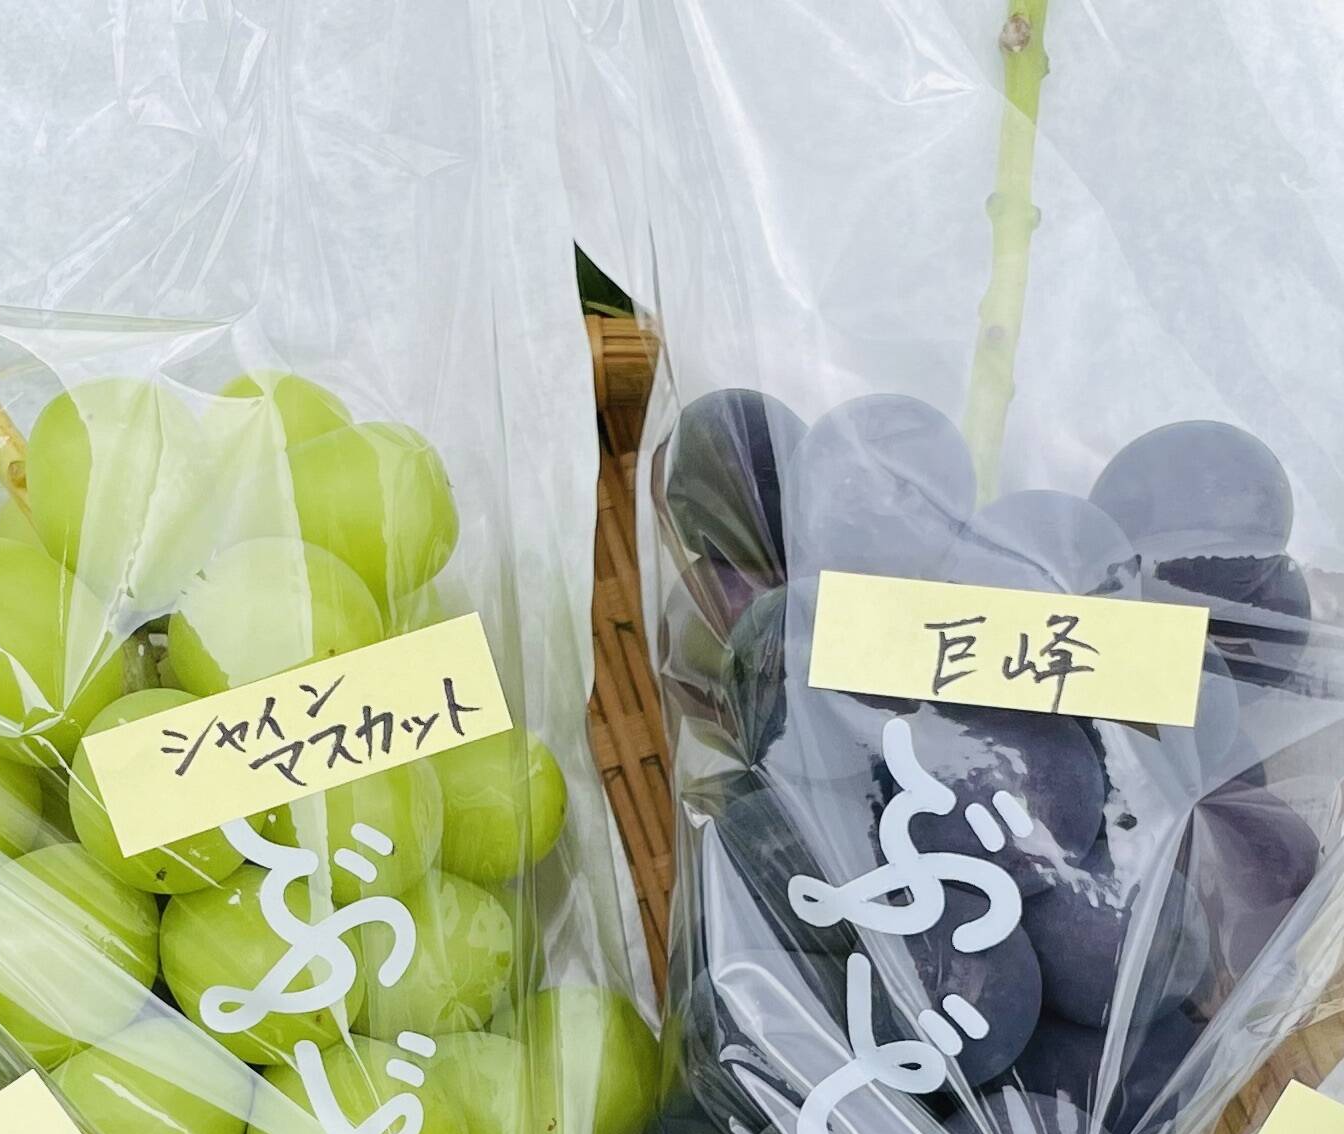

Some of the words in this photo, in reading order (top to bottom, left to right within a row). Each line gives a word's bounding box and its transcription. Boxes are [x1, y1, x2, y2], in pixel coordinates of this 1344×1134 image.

[925, 613, 1099, 711] 巨峰
[161, 675, 345, 776] シャイン
[249, 678, 480, 786] マスカット
